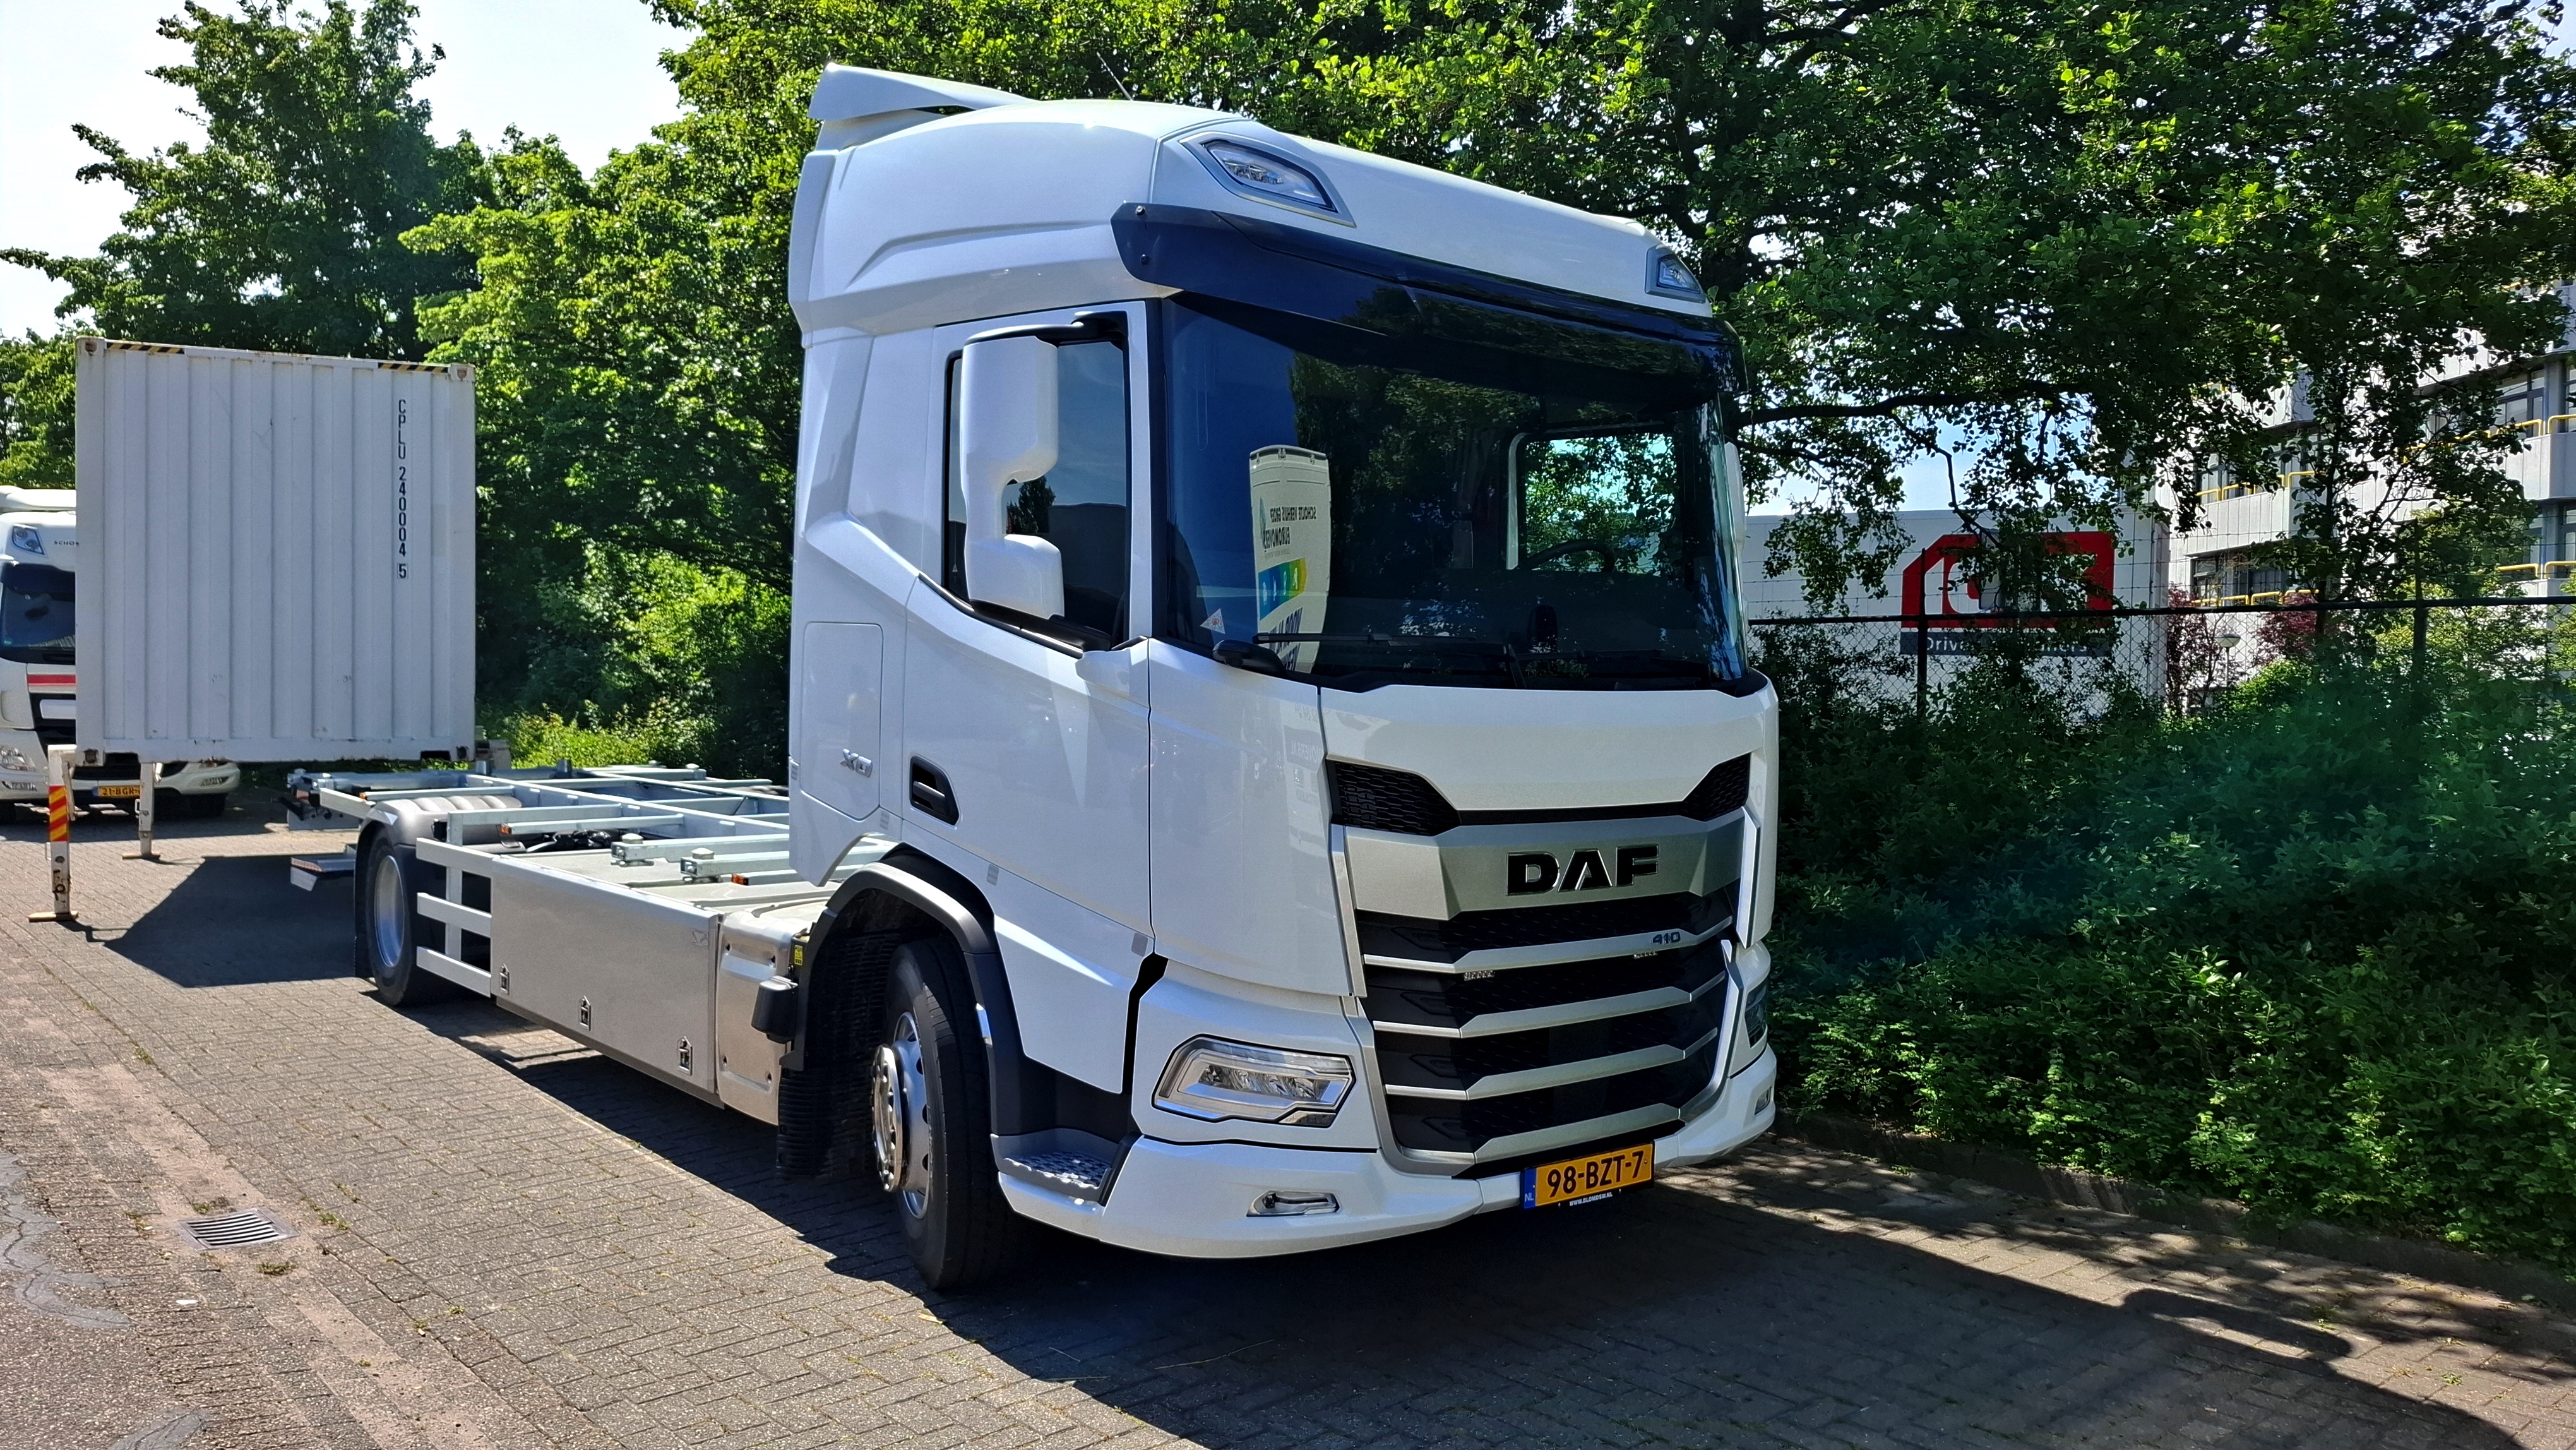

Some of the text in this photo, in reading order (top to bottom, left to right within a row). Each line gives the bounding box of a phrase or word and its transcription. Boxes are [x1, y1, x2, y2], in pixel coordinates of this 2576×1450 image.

[398, 398, 407, 578] CPLU 240004 5
[1506, 842, 1659, 896] DAF
[1651, 931, 1681, 945] 410
[1524, 1192, 1535, 1202] NL
[1547, 1150, 1645, 1198] 98-BZT-7
